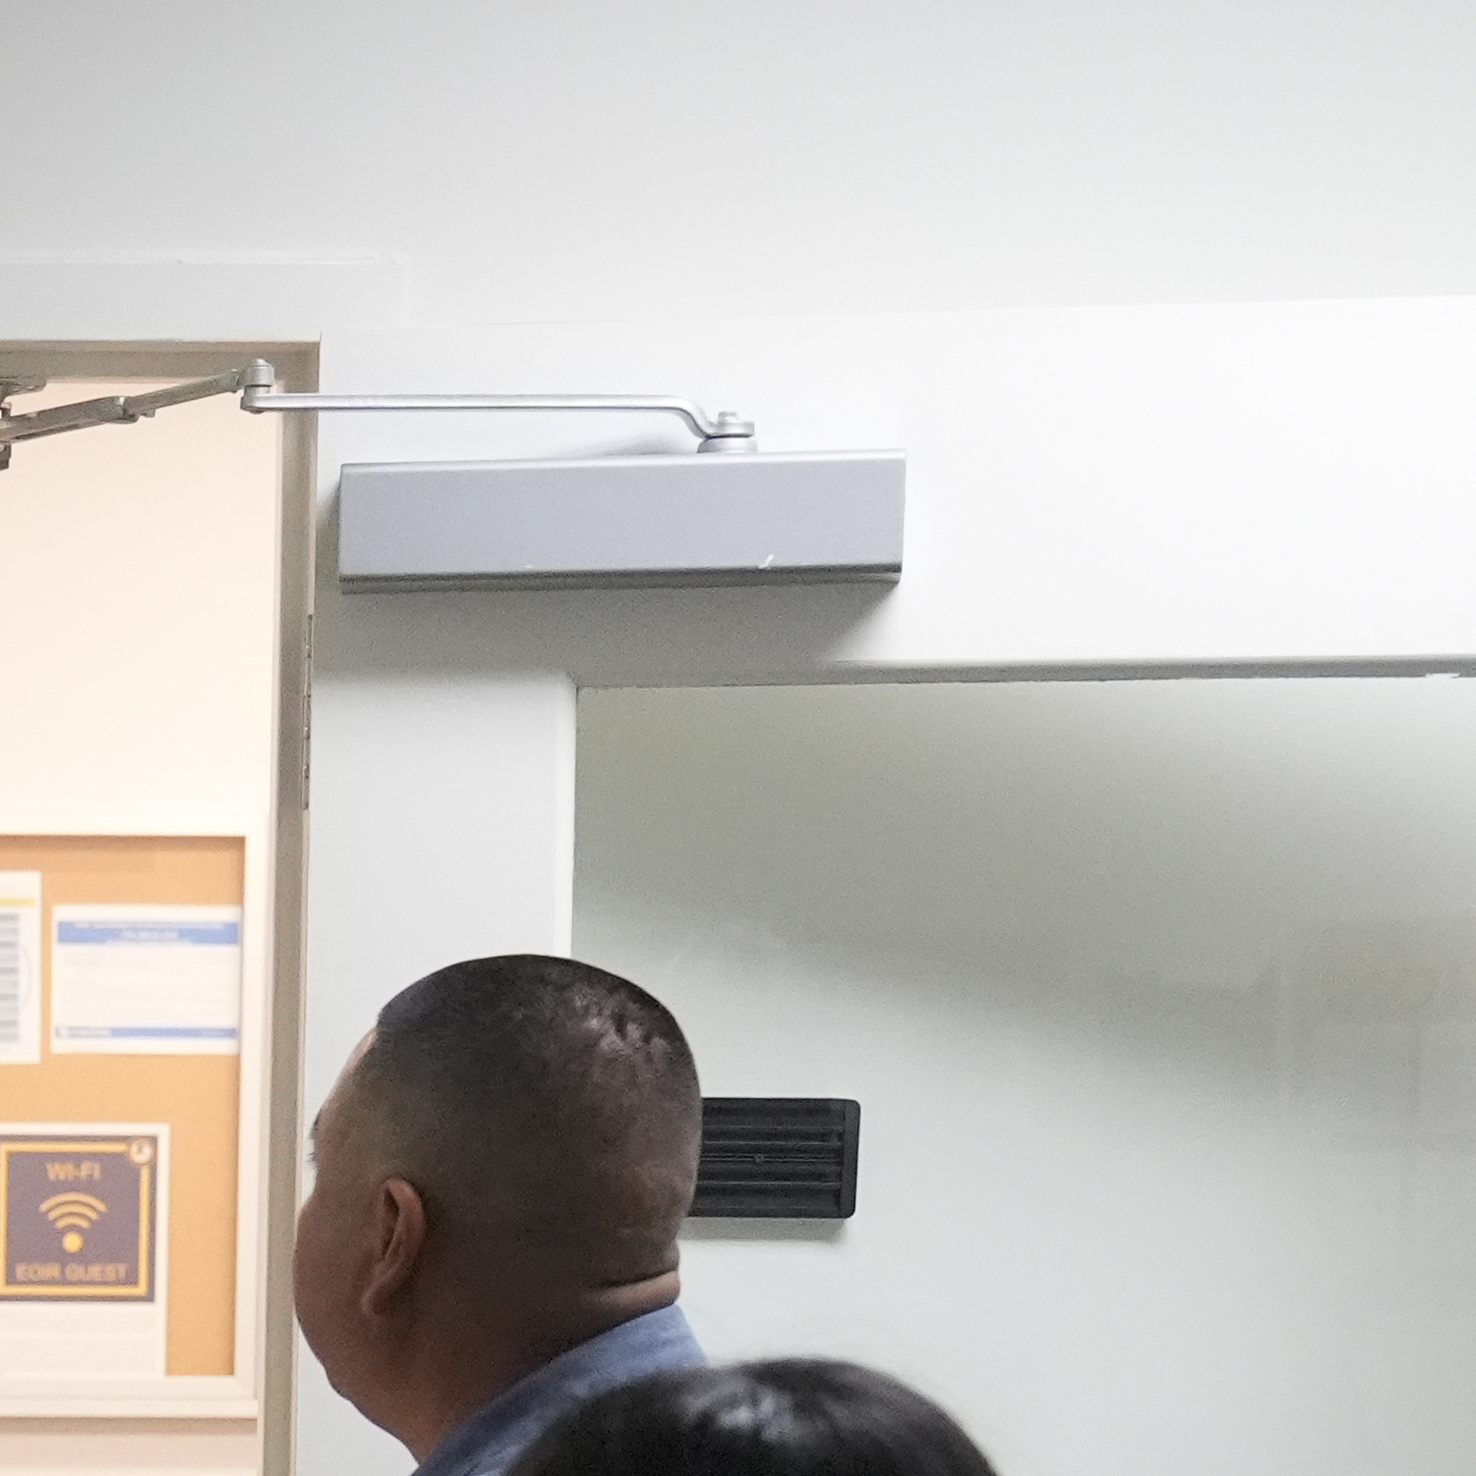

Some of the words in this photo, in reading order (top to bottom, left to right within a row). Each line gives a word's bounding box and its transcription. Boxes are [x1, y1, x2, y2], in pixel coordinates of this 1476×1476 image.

[47, 1161, 100, 1180] WI-FI
[15, 1262, 62, 1281] EOIR
[65, 1262, 128, 1281] GUEST
